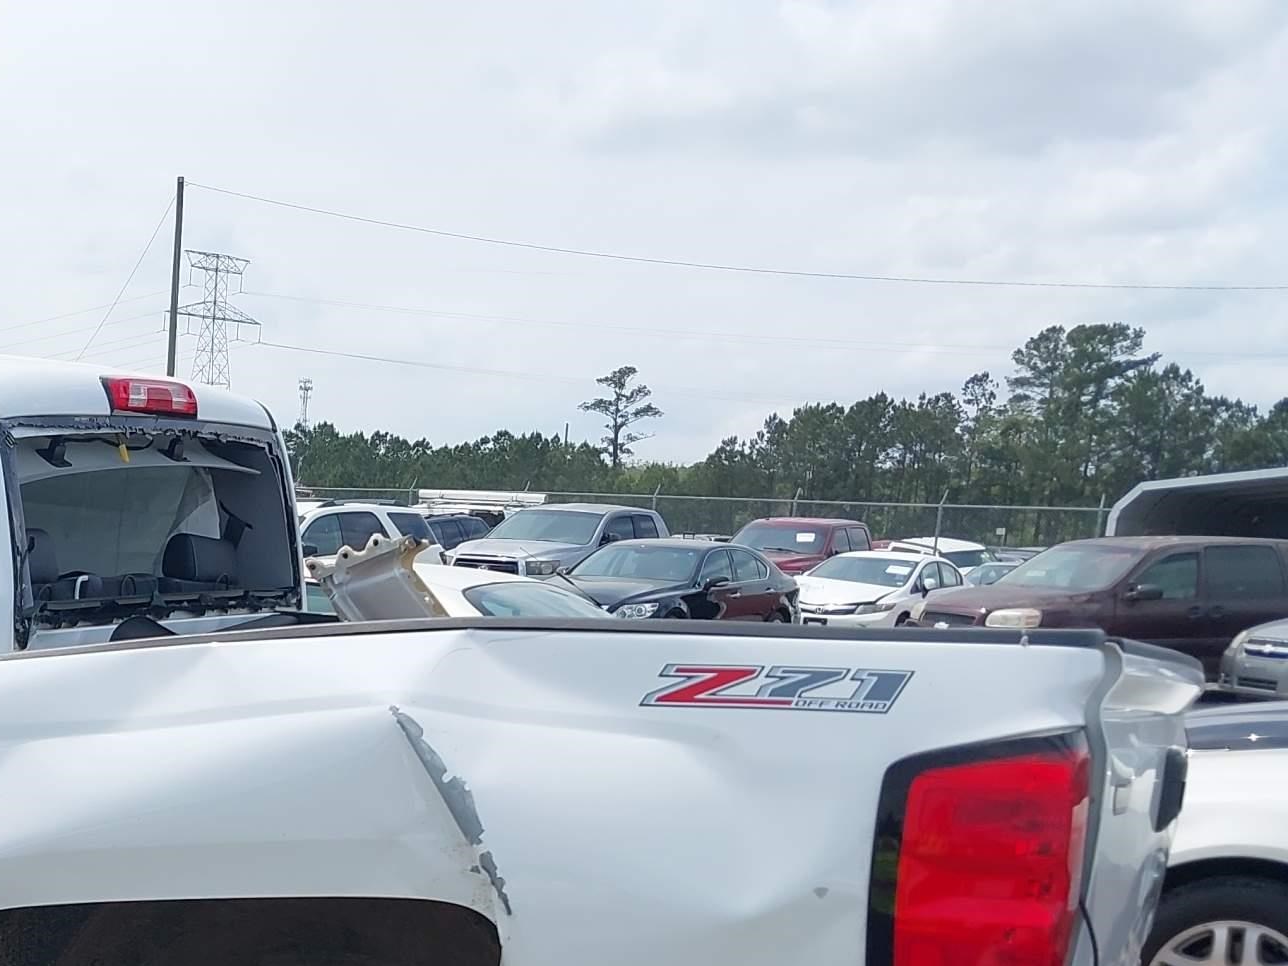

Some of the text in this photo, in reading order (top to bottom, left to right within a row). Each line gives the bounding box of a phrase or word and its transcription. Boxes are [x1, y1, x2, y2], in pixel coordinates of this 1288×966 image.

[639, 663, 916, 714] Z71
[794, 699, 888, 711] OFF ROAD
